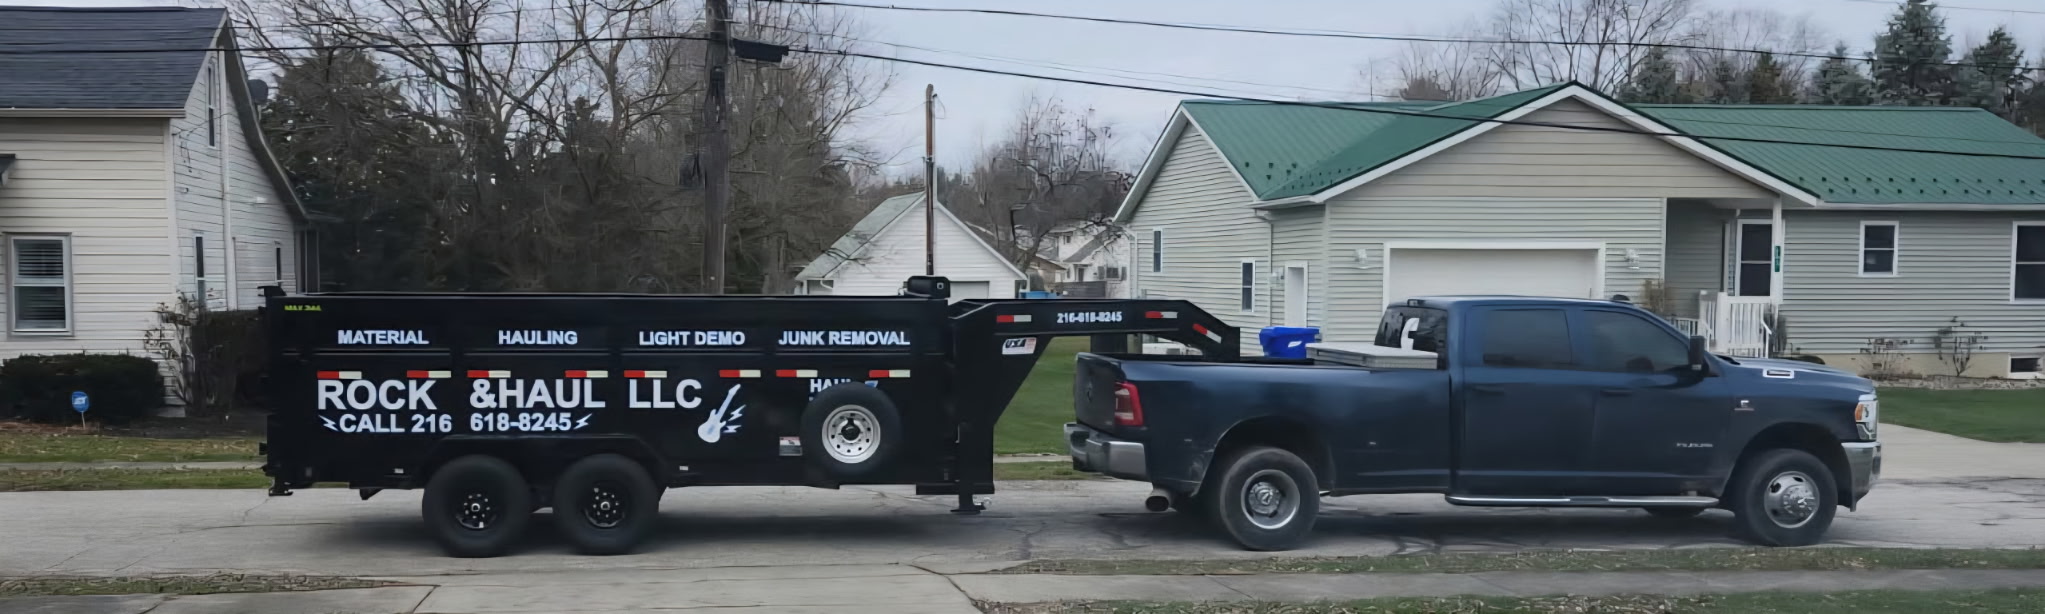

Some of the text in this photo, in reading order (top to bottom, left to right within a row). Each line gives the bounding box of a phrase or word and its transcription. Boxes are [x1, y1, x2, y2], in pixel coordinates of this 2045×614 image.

[338, 330, 429, 344] MATERIAL
[499, 330, 577, 344] HAULING
[639, 331, 745, 345] LIGHT DEMO
[779, 331, 910, 345] JUNK REMOVAL
[318, 379, 702, 409] ROCK &HAUL LLC
[339, 412, 572, 432] CALL 216 618-8245
